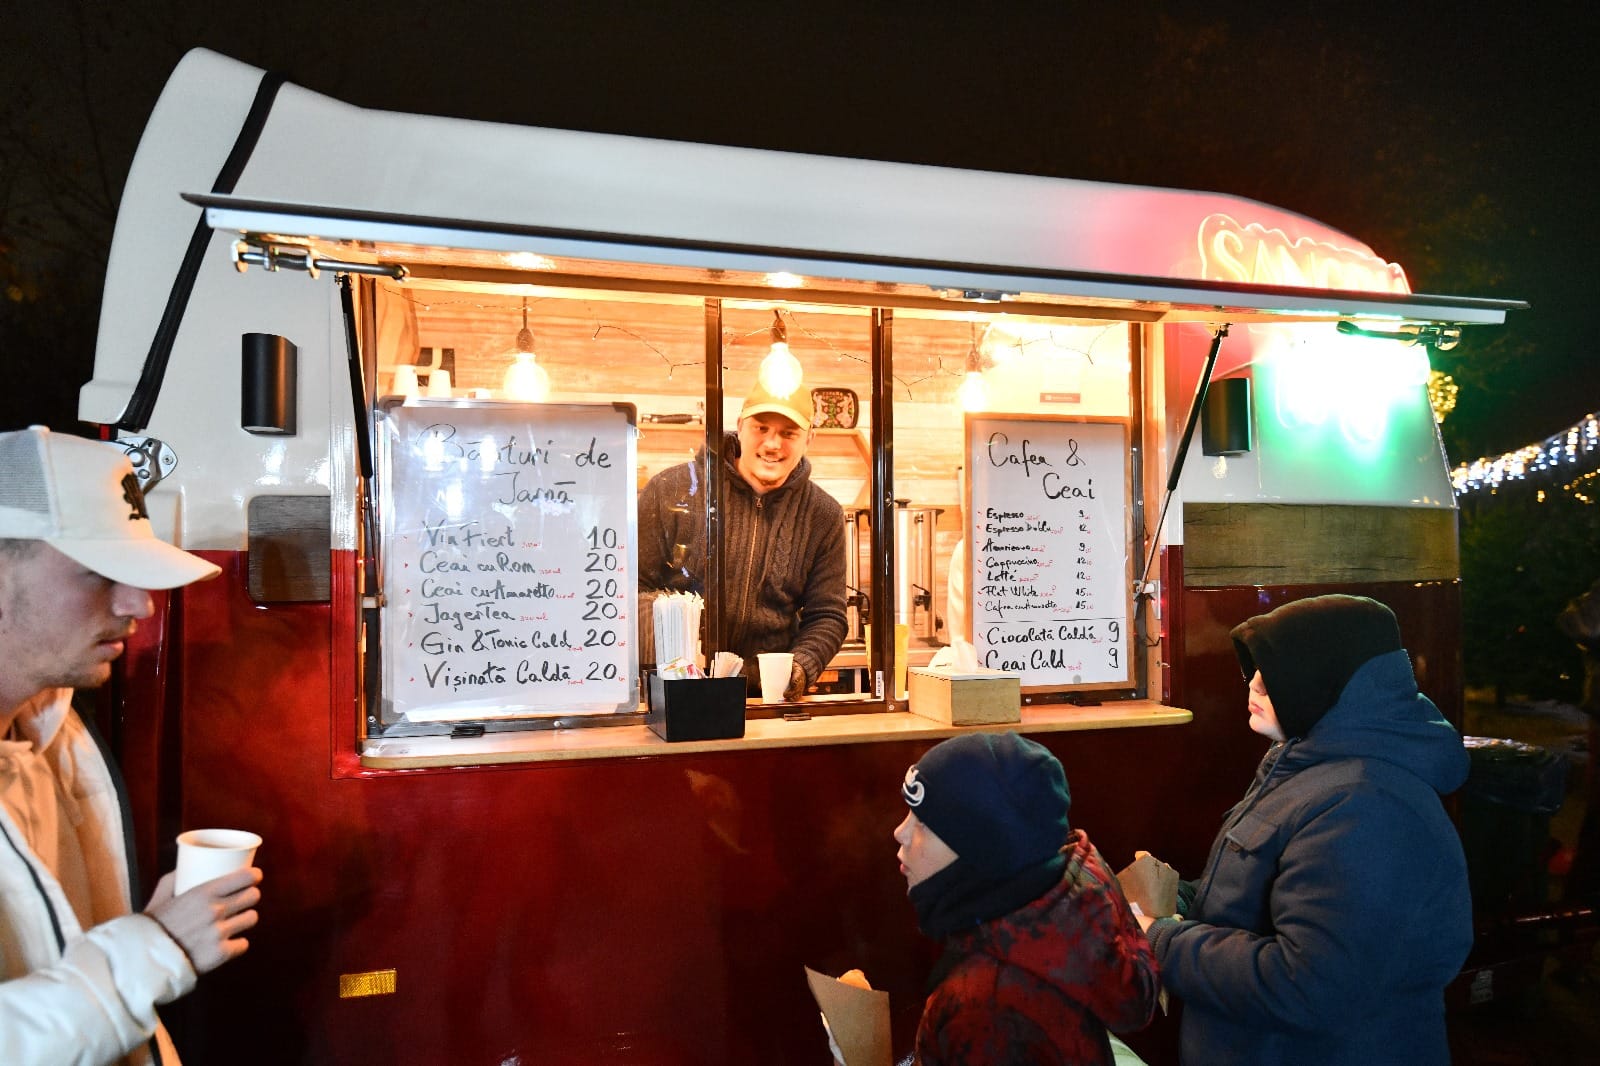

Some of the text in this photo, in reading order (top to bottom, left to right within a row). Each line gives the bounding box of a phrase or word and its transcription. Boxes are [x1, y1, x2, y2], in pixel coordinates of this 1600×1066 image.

[575, 437, 611, 469] de
[988, 432, 1086, 477] Cafea &
[1042, 472, 1095, 500] Ceai
[986, 508, 1024, 522] Espresso
[422, 519, 458, 548] Vin
[460, 525, 515, 548] Fiert
[586, 525, 617, 550] 10
[986, 524, 1024, 538] Espresso
[1078, 543, 1086, 552] 9
[420, 551, 471, 574] Ceai
[584, 552, 617, 572] 20
[1077, 558, 1086, 566] 12
[1076, 572, 1086, 580] 12
[421, 578, 461, 599] Ceai
[585, 578, 617, 599] 20
[1076, 588, 1087, 597] 15
[582, 600, 618, 621] 20
[1076, 601, 1086, 610] 15
[421, 631, 464, 655] Gin
[472, 630, 489, 652] &
[485, 629, 527, 649] Tonic
[532, 630, 571, 649] Cald
[584, 628, 616, 647] 20
[1109, 621, 1119, 642] 9
[986, 650, 1026, 670] Ceai
[1031, 649, 1065, 670] Cald
[1109, 648, 1118, 668] 9
[585, 661, 617, 680] 20
